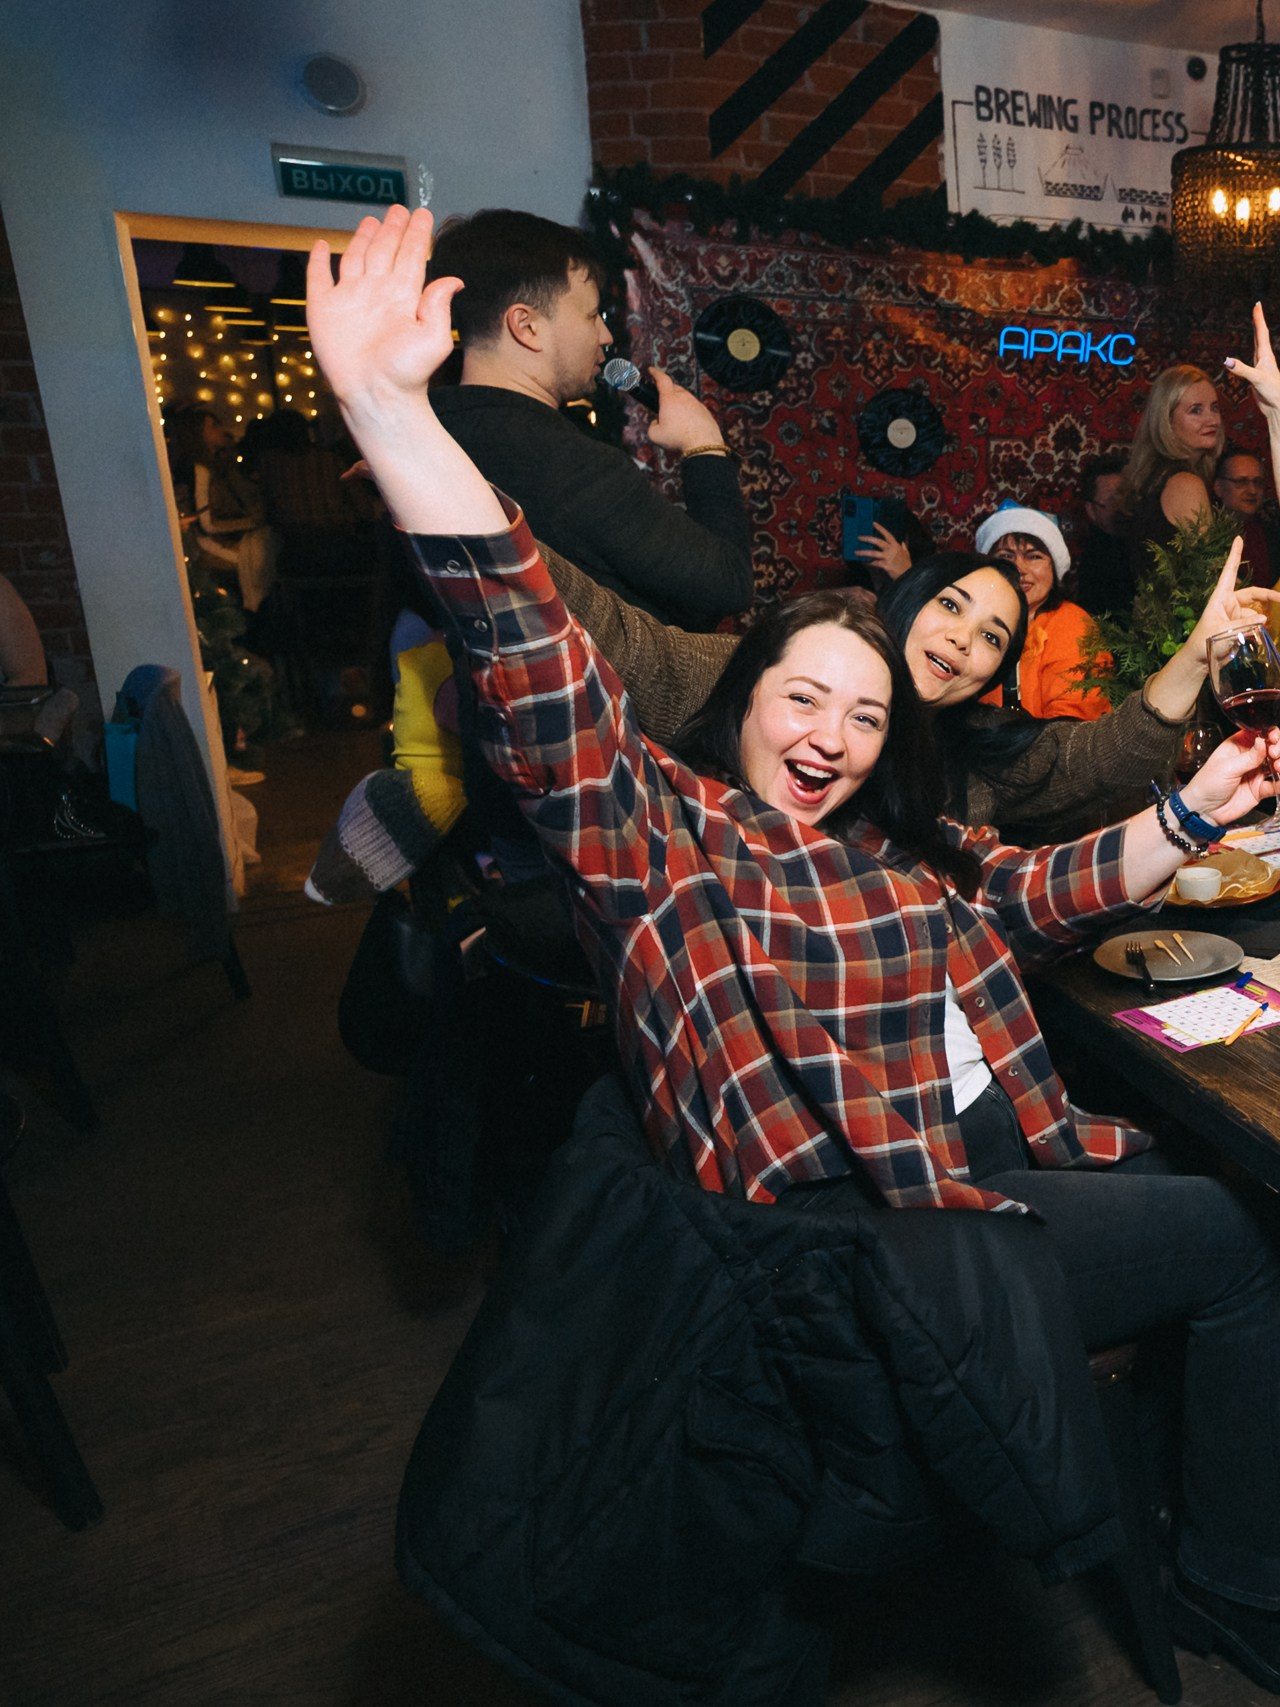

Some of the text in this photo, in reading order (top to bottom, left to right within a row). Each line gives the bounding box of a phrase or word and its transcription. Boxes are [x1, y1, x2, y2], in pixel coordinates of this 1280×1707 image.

[974, 85, 1189, 145] BREWING PROCESS
[291, 168, 398, 200] ВЫХОД
[999, 326, 1136, 366] АРАКС
